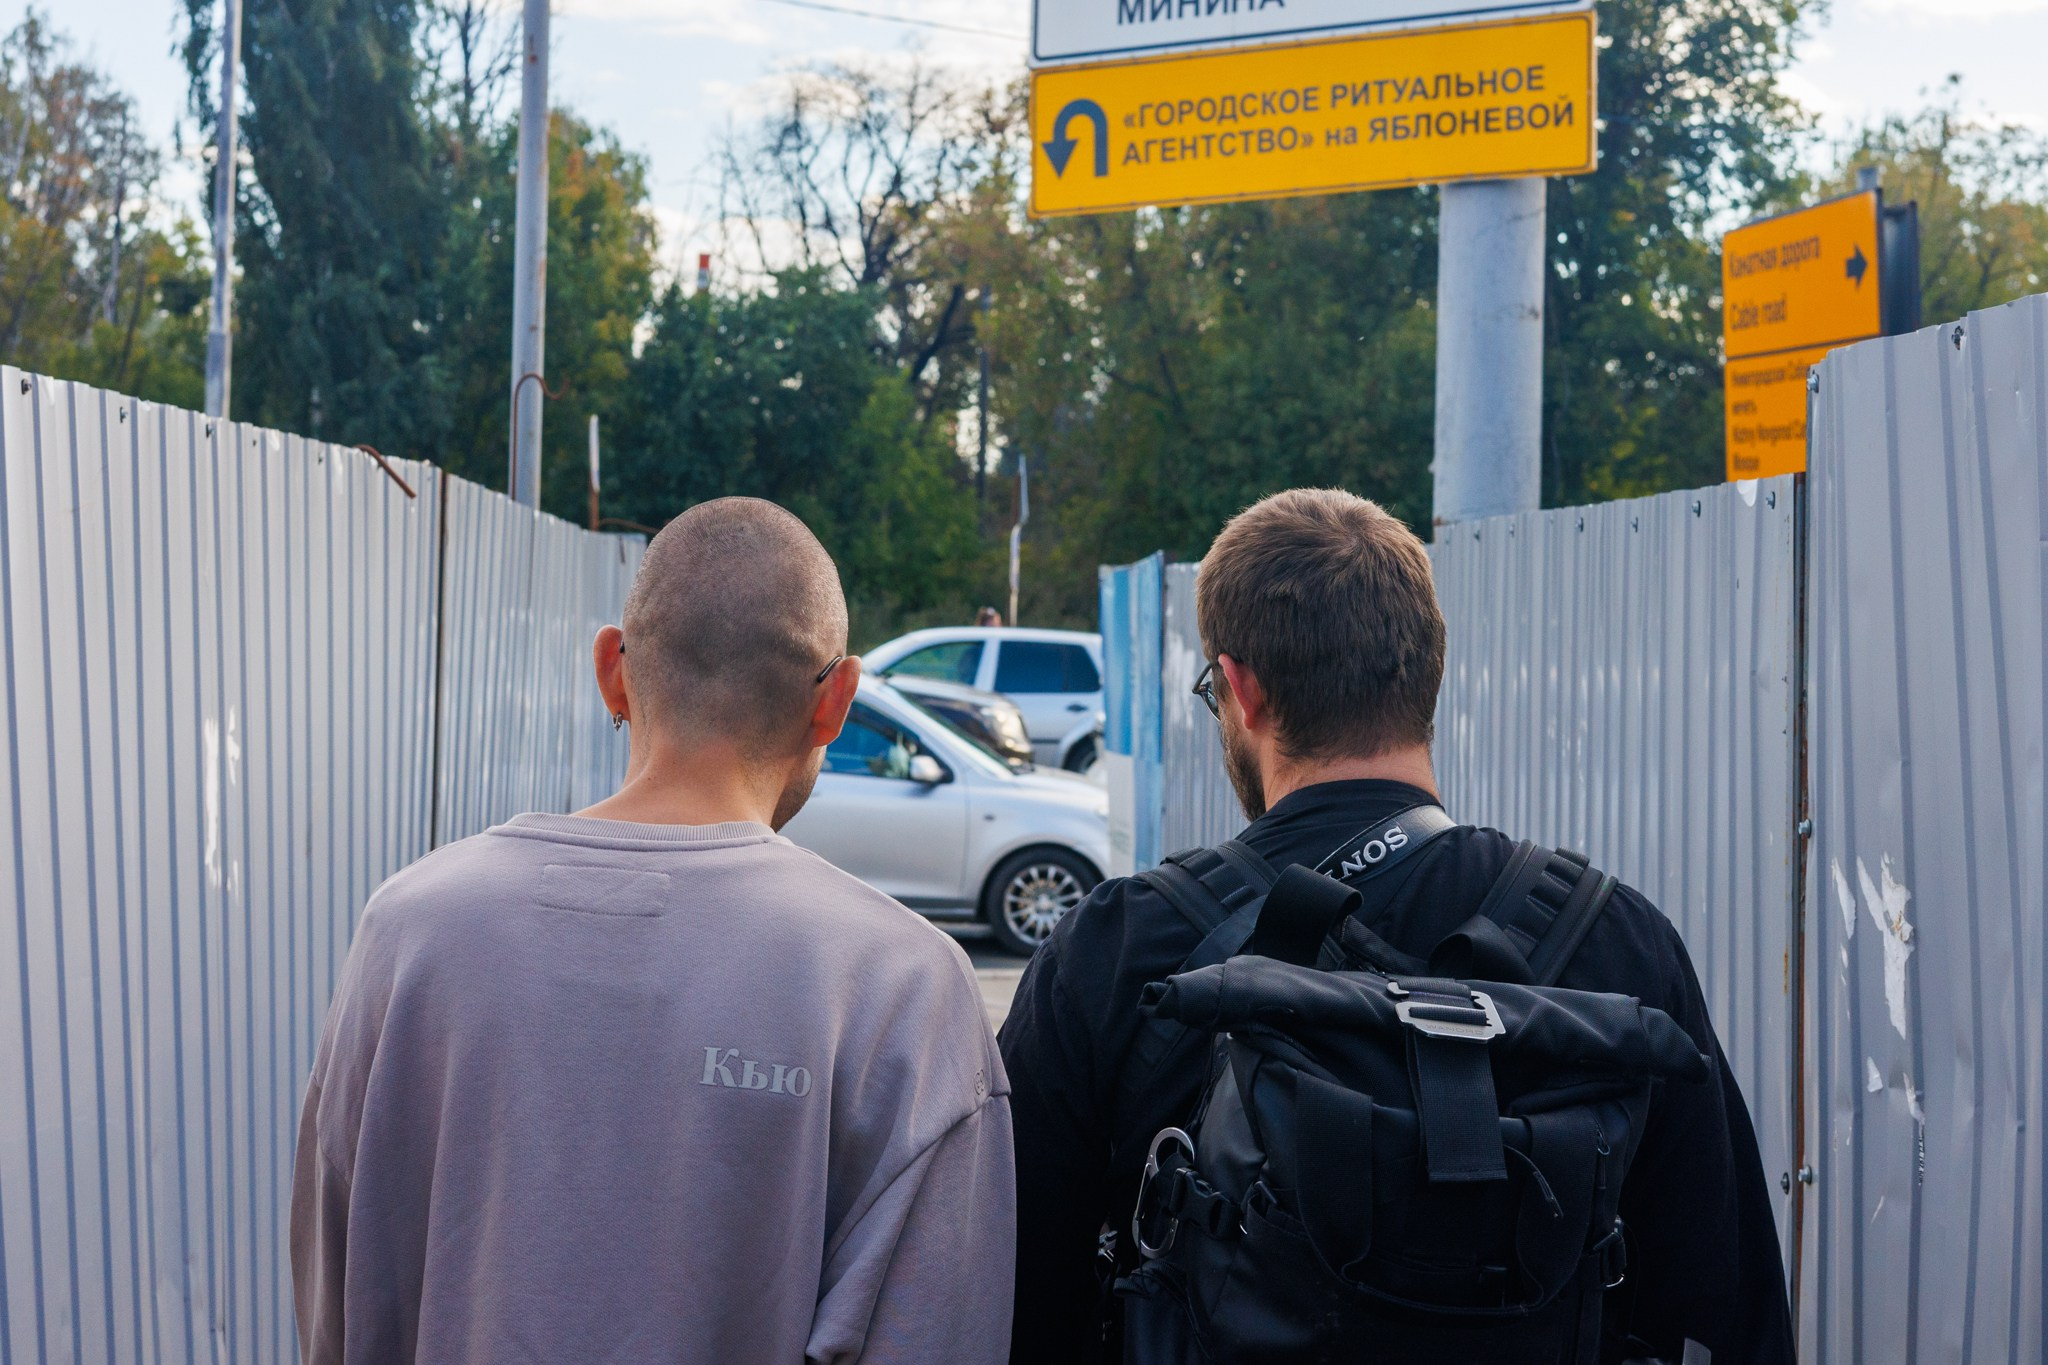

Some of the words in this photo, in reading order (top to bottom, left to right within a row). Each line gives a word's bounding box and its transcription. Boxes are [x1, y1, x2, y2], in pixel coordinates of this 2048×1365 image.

[1117, 0, 1286, 25] МИН
[1123, 86, 1320, 128] «ГОРОДСКОЕ
[1330, 65, 1545, 109] РИТУАЛЬНОЕ
[1122, 126, 1314, 166] АГЕНТСТВО»
[1325, 126, 1358, 147] на
[1368, 95, 1574, 143] ЯБЛОНЕВОЙ
[700, 1046, 813, 1098] Кью
